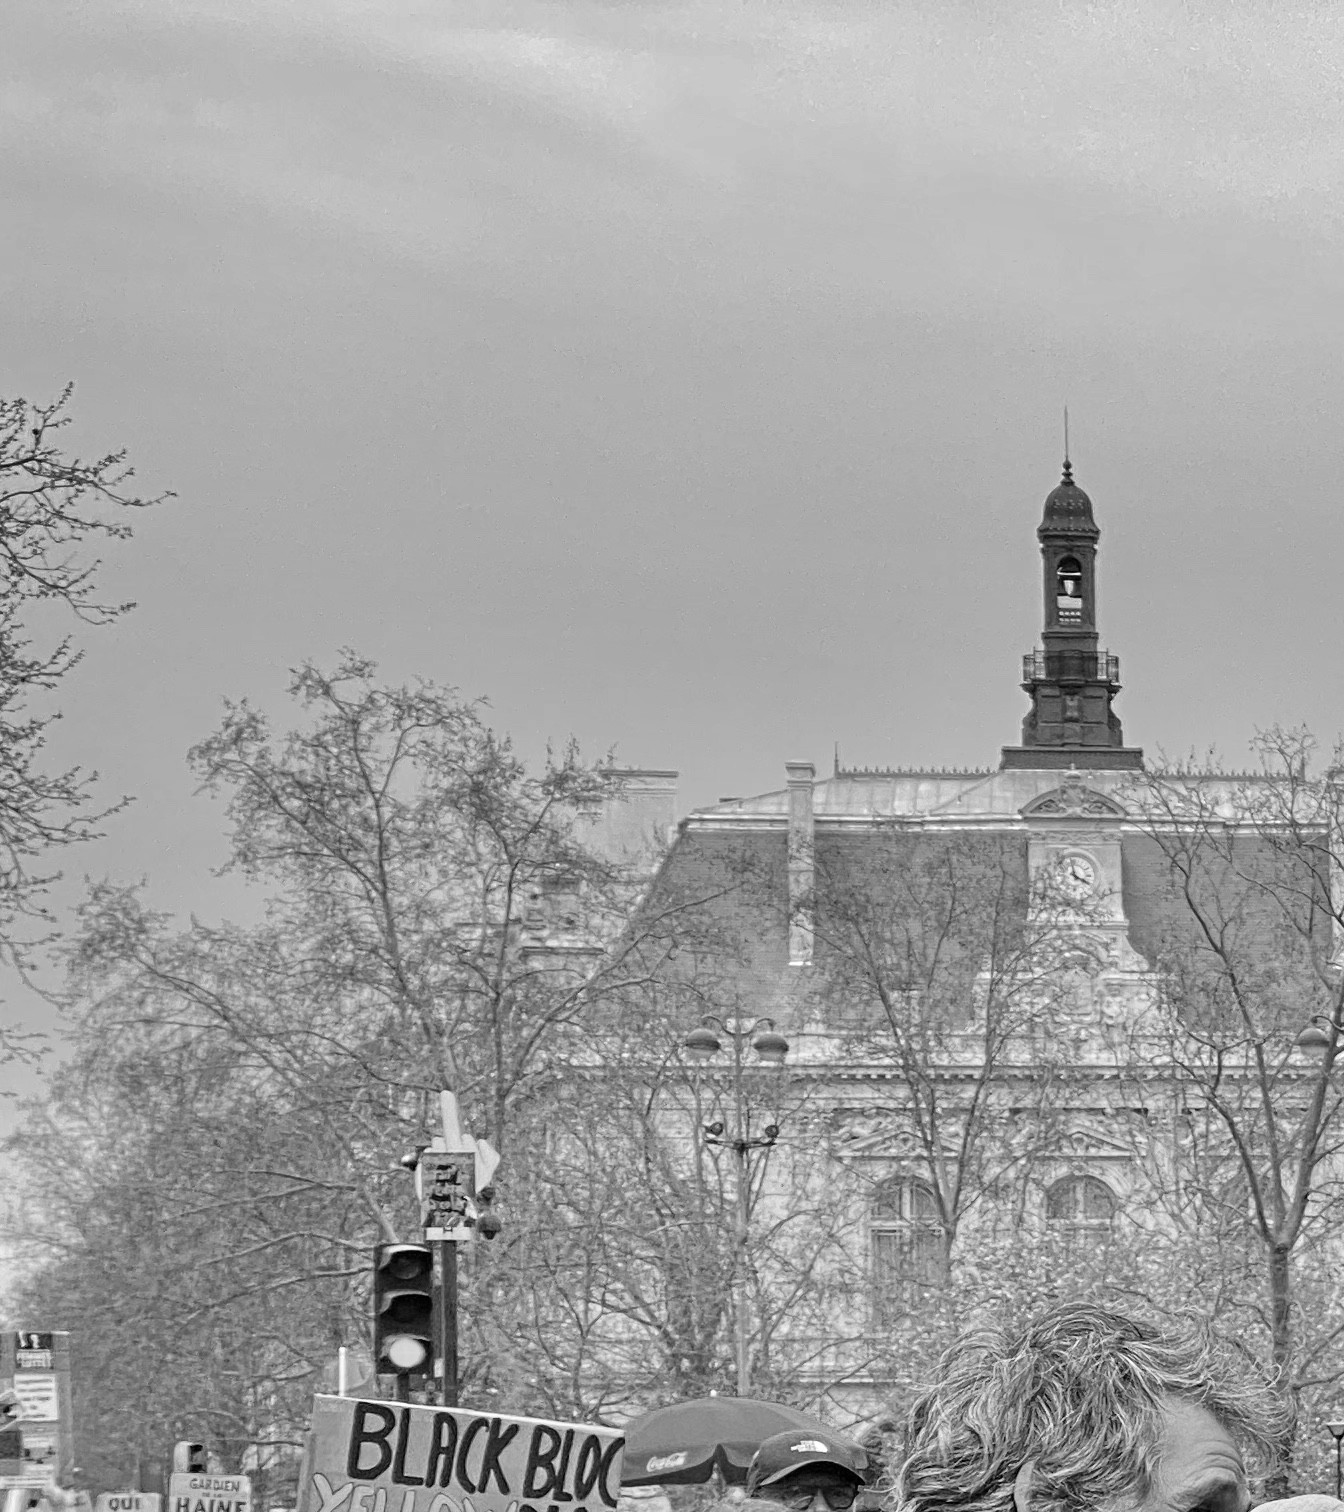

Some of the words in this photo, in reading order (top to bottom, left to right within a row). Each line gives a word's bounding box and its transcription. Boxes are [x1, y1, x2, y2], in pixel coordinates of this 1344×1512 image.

[347, 1401, 519, 1496] BLACK
[522, 1424, 626, 1508] BLOC
[108, 1497, 140, 1511] QUI
